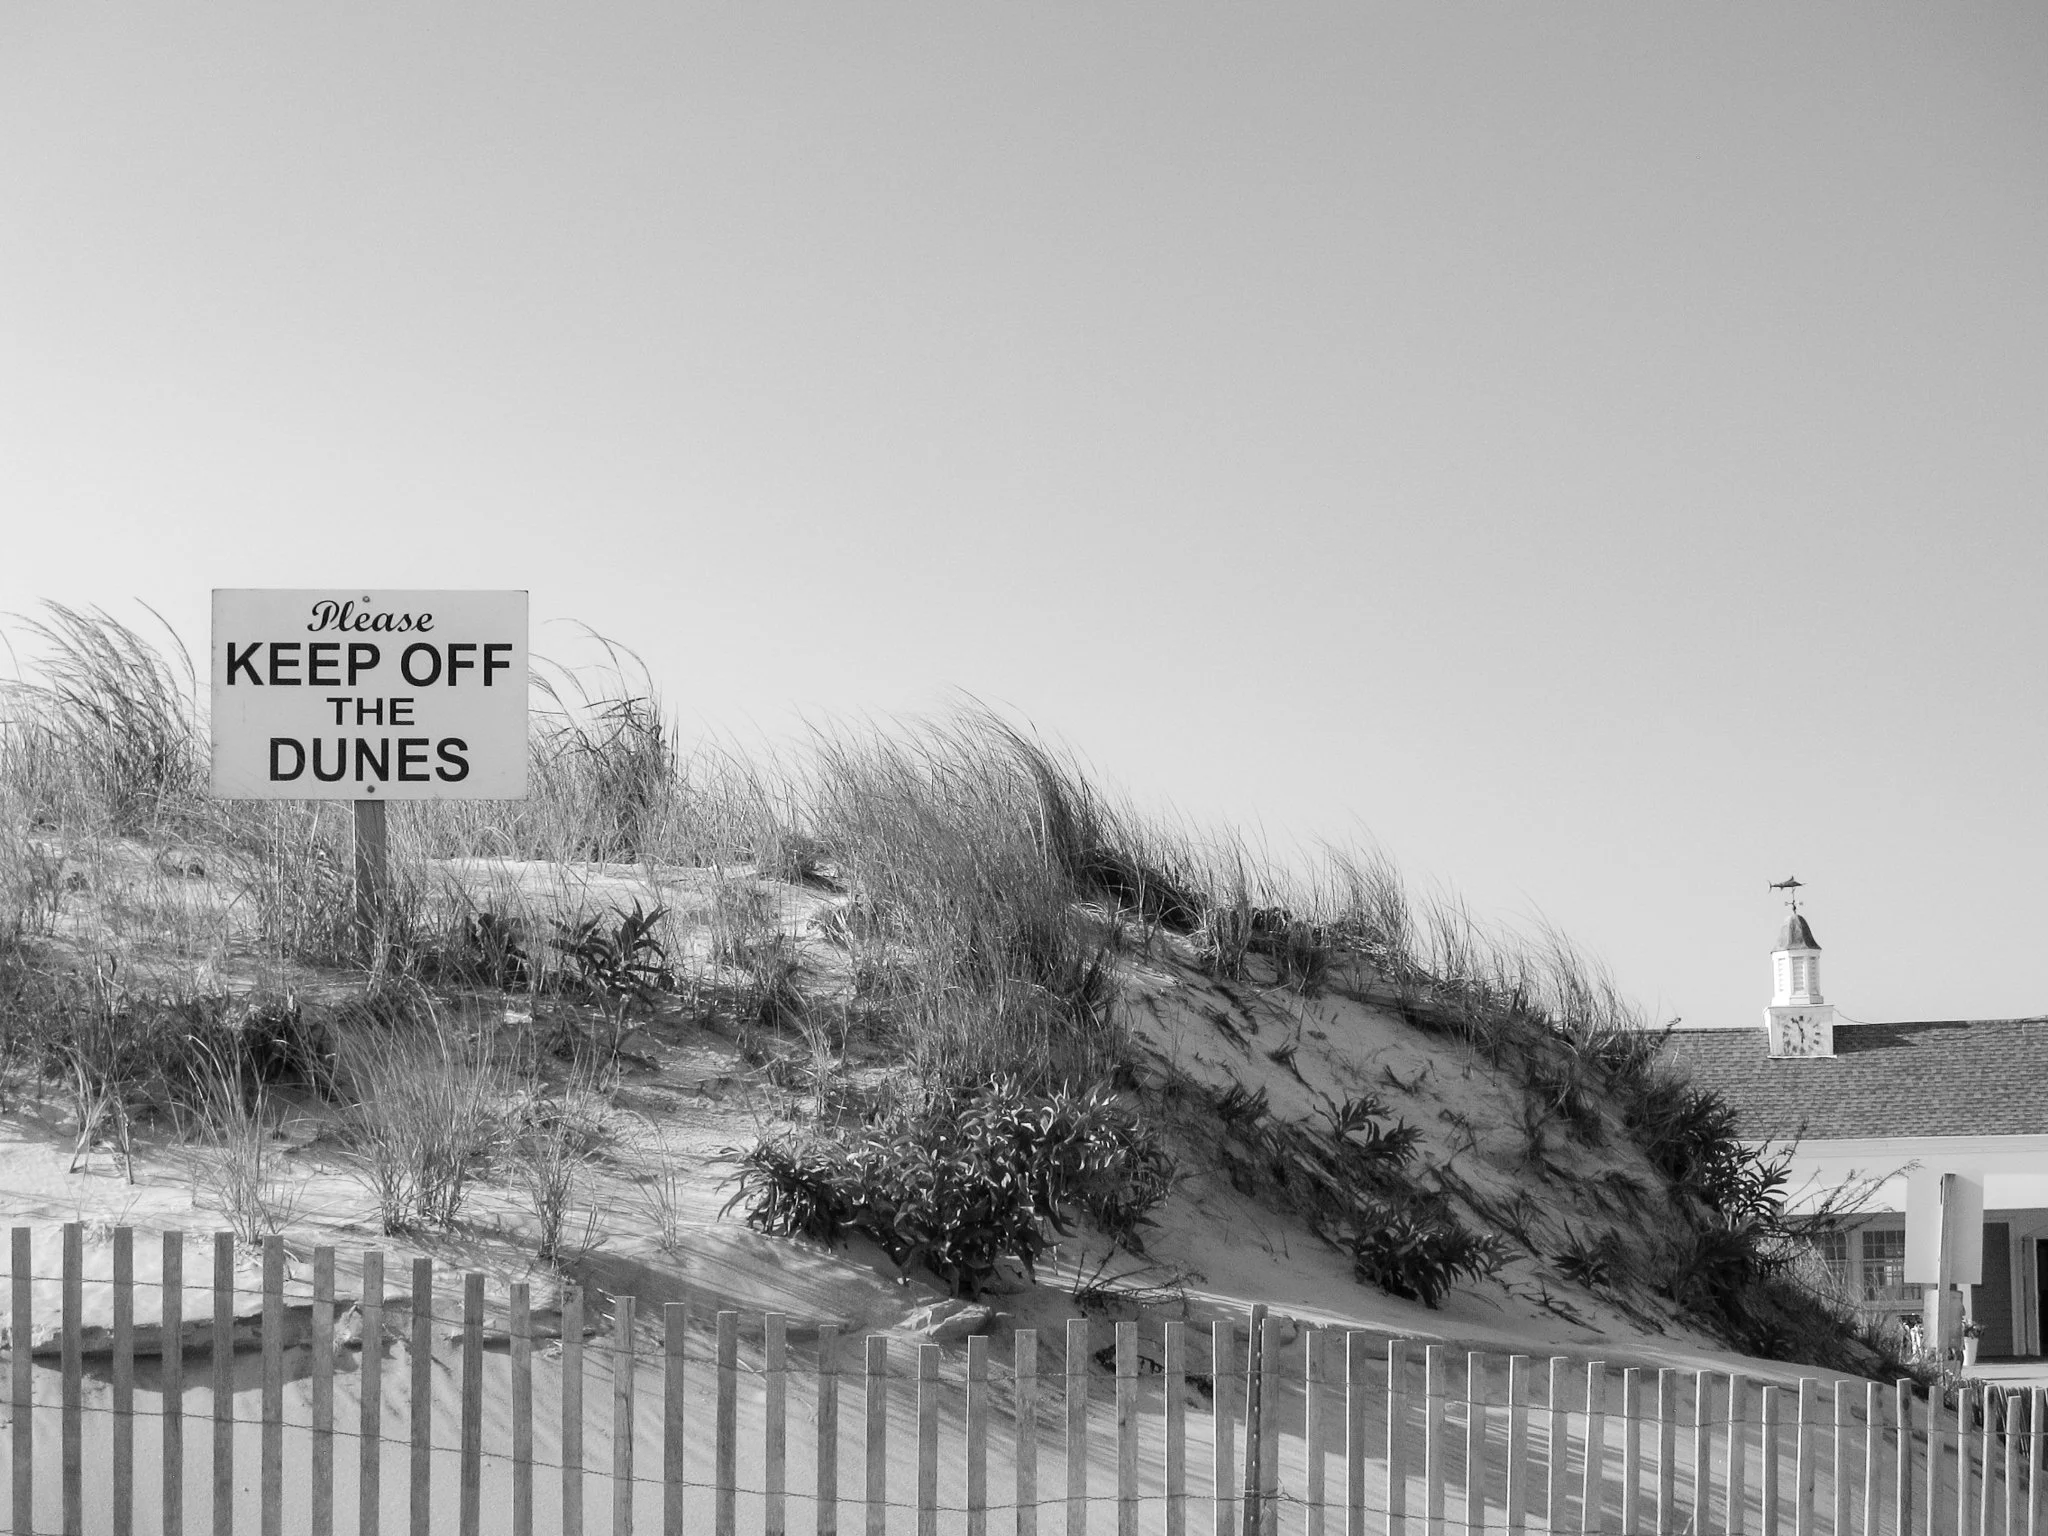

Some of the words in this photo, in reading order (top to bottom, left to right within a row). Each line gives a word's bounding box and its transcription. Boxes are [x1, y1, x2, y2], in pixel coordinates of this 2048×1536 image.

[307, 600, 434, 632] Please
[226, 642, 381, 687] KEEP
[400, 642, 513, 687] OFF
[326, 697, 415, 726] THE
[269, 737, 470, 783] DUNES
